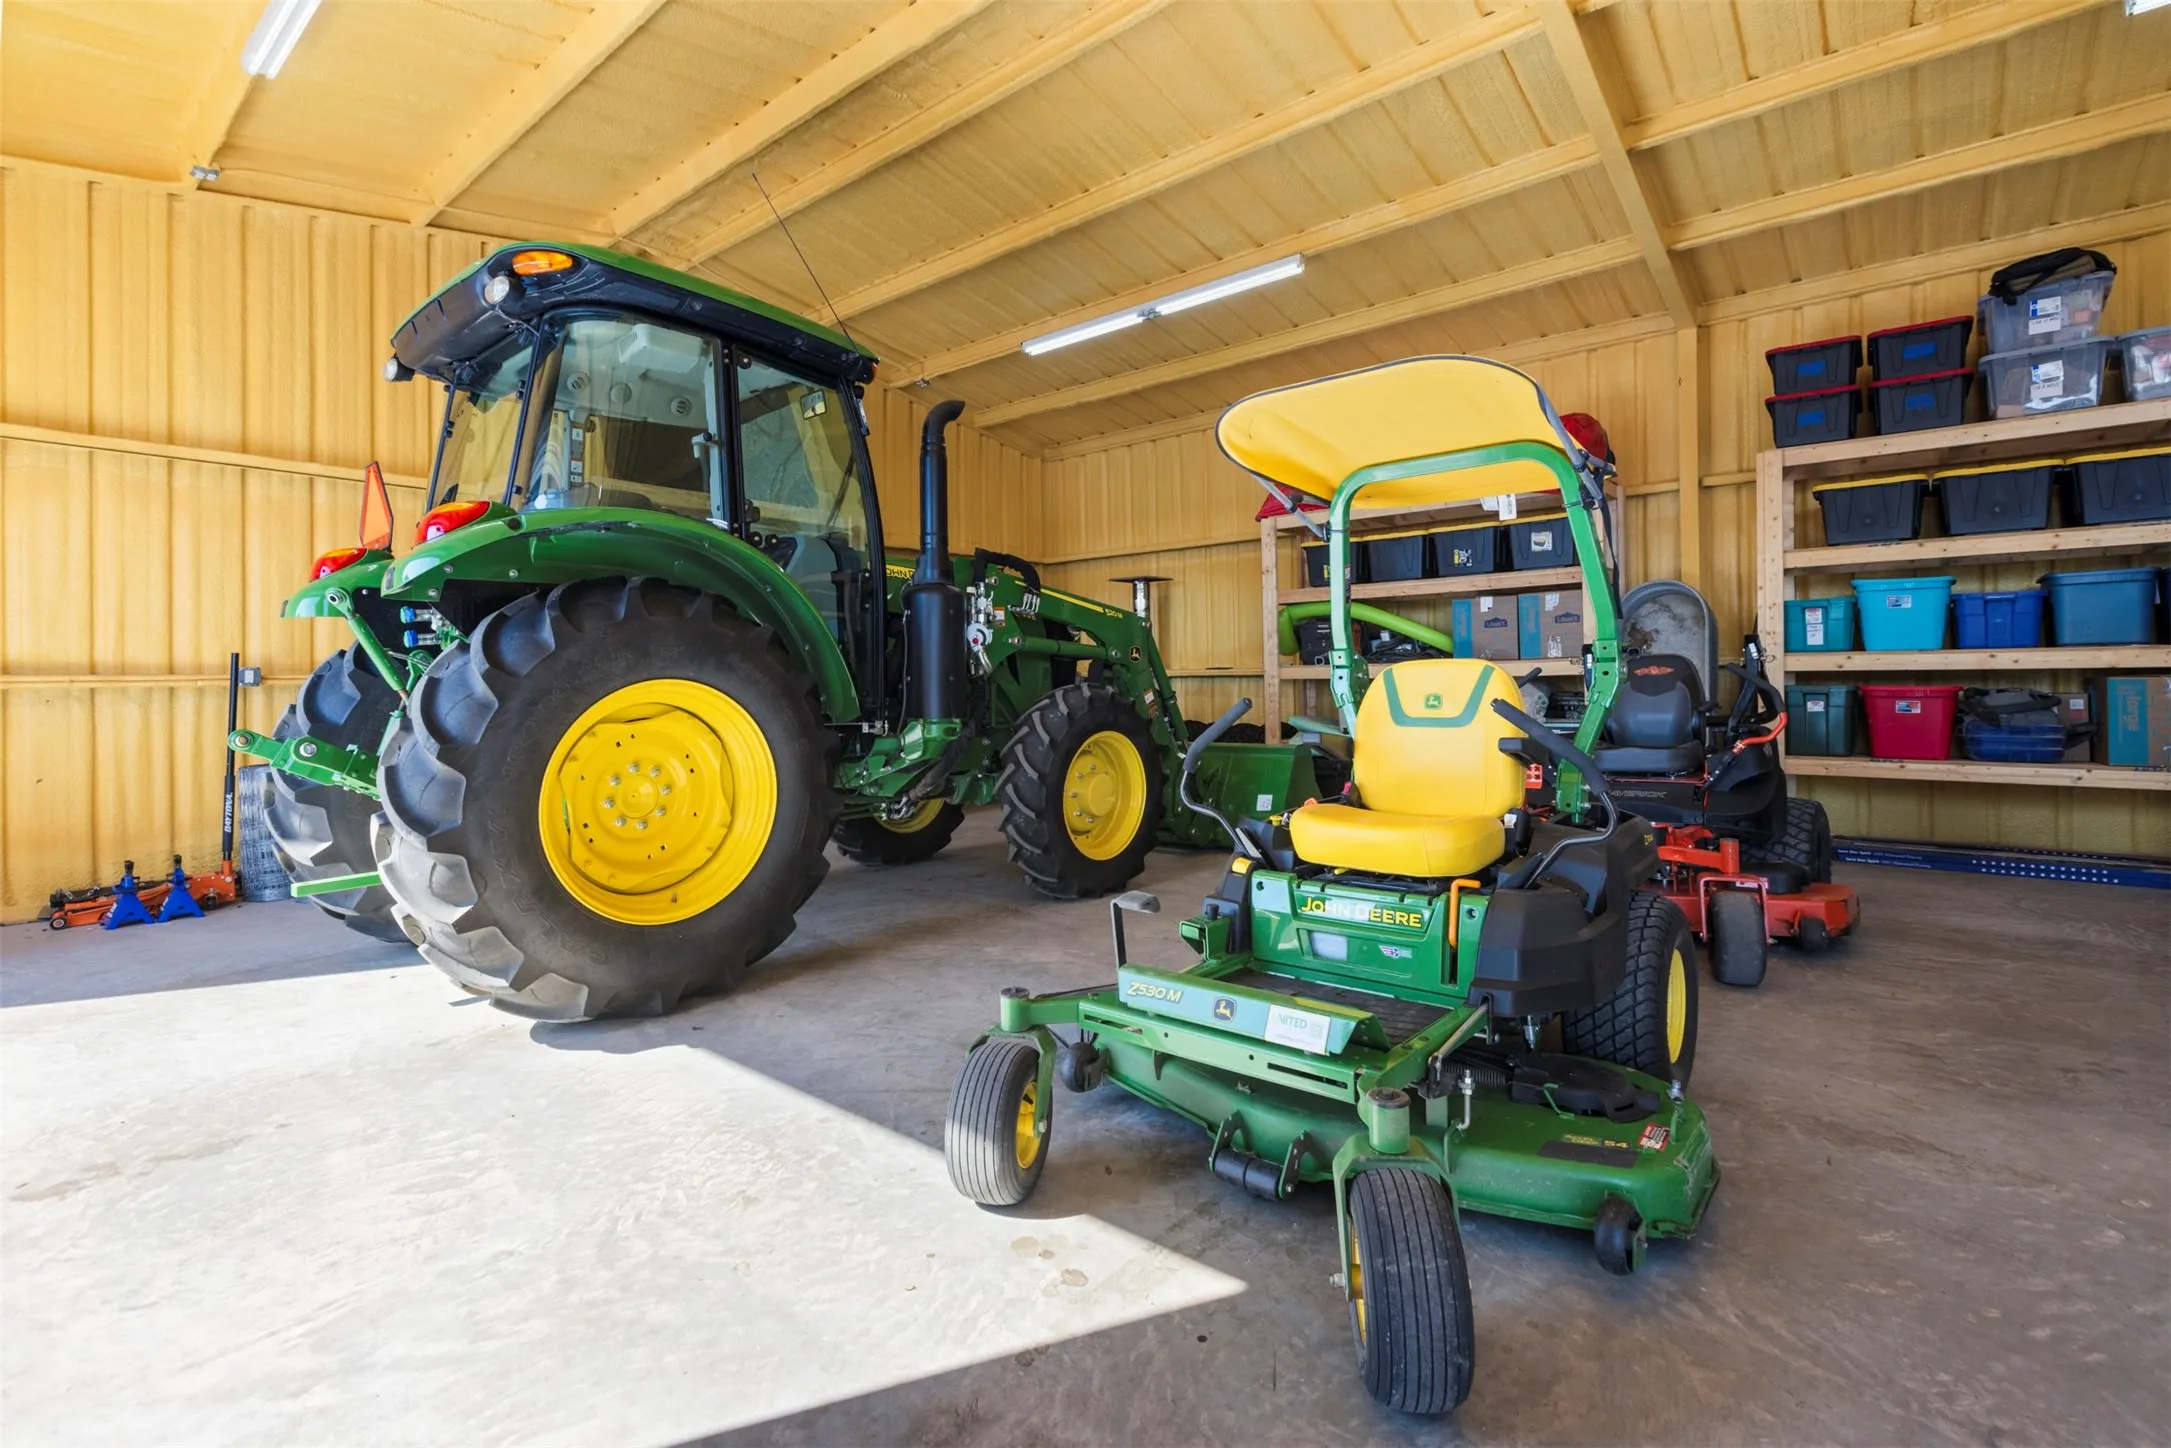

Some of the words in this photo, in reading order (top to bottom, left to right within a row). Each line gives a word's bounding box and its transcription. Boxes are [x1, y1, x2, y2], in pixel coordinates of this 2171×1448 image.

[886, 568, 907, 578] OHN
[1301, 896, 1349, 917] JOHN
[1355, 902, 1422, 928] DEERE
[1278, 1012, 1308, 1030] NITED
